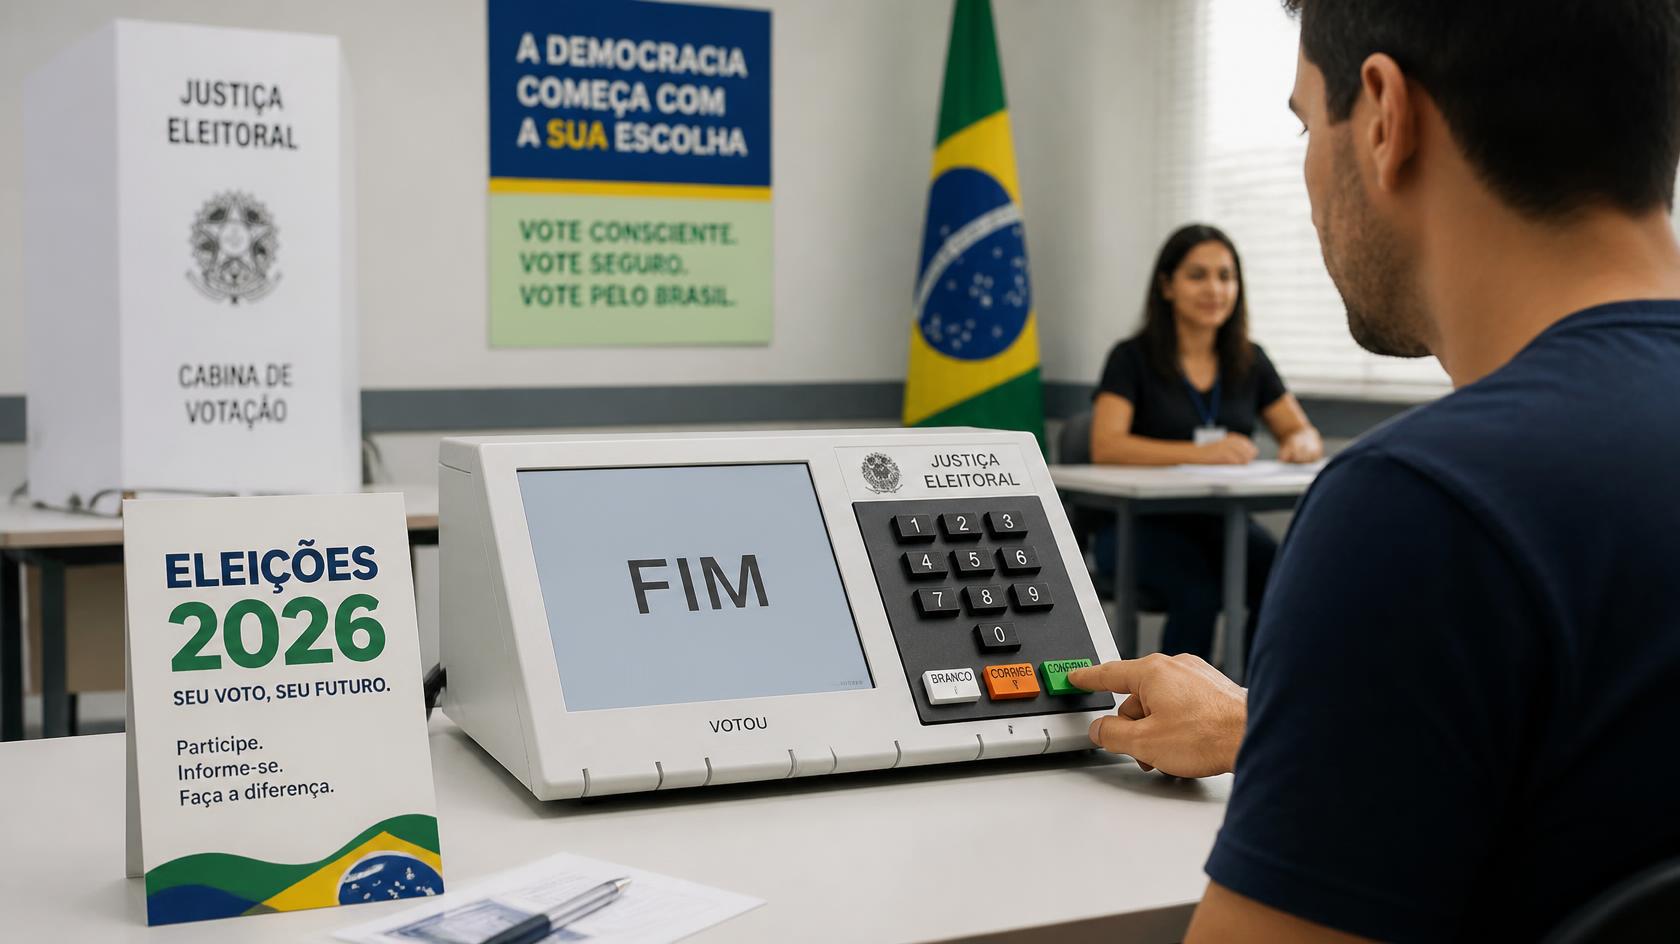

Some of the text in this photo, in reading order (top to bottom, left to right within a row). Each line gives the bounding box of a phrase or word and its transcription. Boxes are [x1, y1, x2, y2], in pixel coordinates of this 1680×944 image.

[517, 33, 748, 78] A DEMOCRACIA
[180, 80, 283, 115] JUSTIÇA
[517, 75, 725, 118] COMEÇA COM
[168, 117, 297, 150] ELEITORAL
[517, 117, 747, 156] A SUA ESCOLHA
[519, 220, 736, 245] VOTE CONSCIENTE.
[520, 252, 688, 276] VOTE SEGURO.
[520, 284, 735, 307] VOTE PELO BRASIL.
[179, 363, 292, 388] CABINA DE
[185, 394, 286, 429] VOTAÇÃO
[931, 454, 1000, 469] JUSTIÇA
[924, 473, 1020, 488] ELEITORAL
[911, 514, 1013, 532] 1 2 3
[165, 539, 379, 593] ELEIÇÕES
[922, 550, 1026, 569] 4 5 6
[628, 555, 769, 614] FIM
[933, 587, 1038, 607] 7 8 9
[168, 593, 386, 672] 2026
[994, 627, 1005, 642] 0
[930, 671, 973, 684] BRANCO
[990, 666, 1033, 679] CORRIGE
[174, 678, 390, 706] SEU VOTO, SEU FUTURO.
[709, 717, 767, 733] VOTOU
[177, 736, 263, 755] Participe.
[178, 761, 284, 781] Informe-se.
[180, 782, 334, 808] Faça a diferença.
